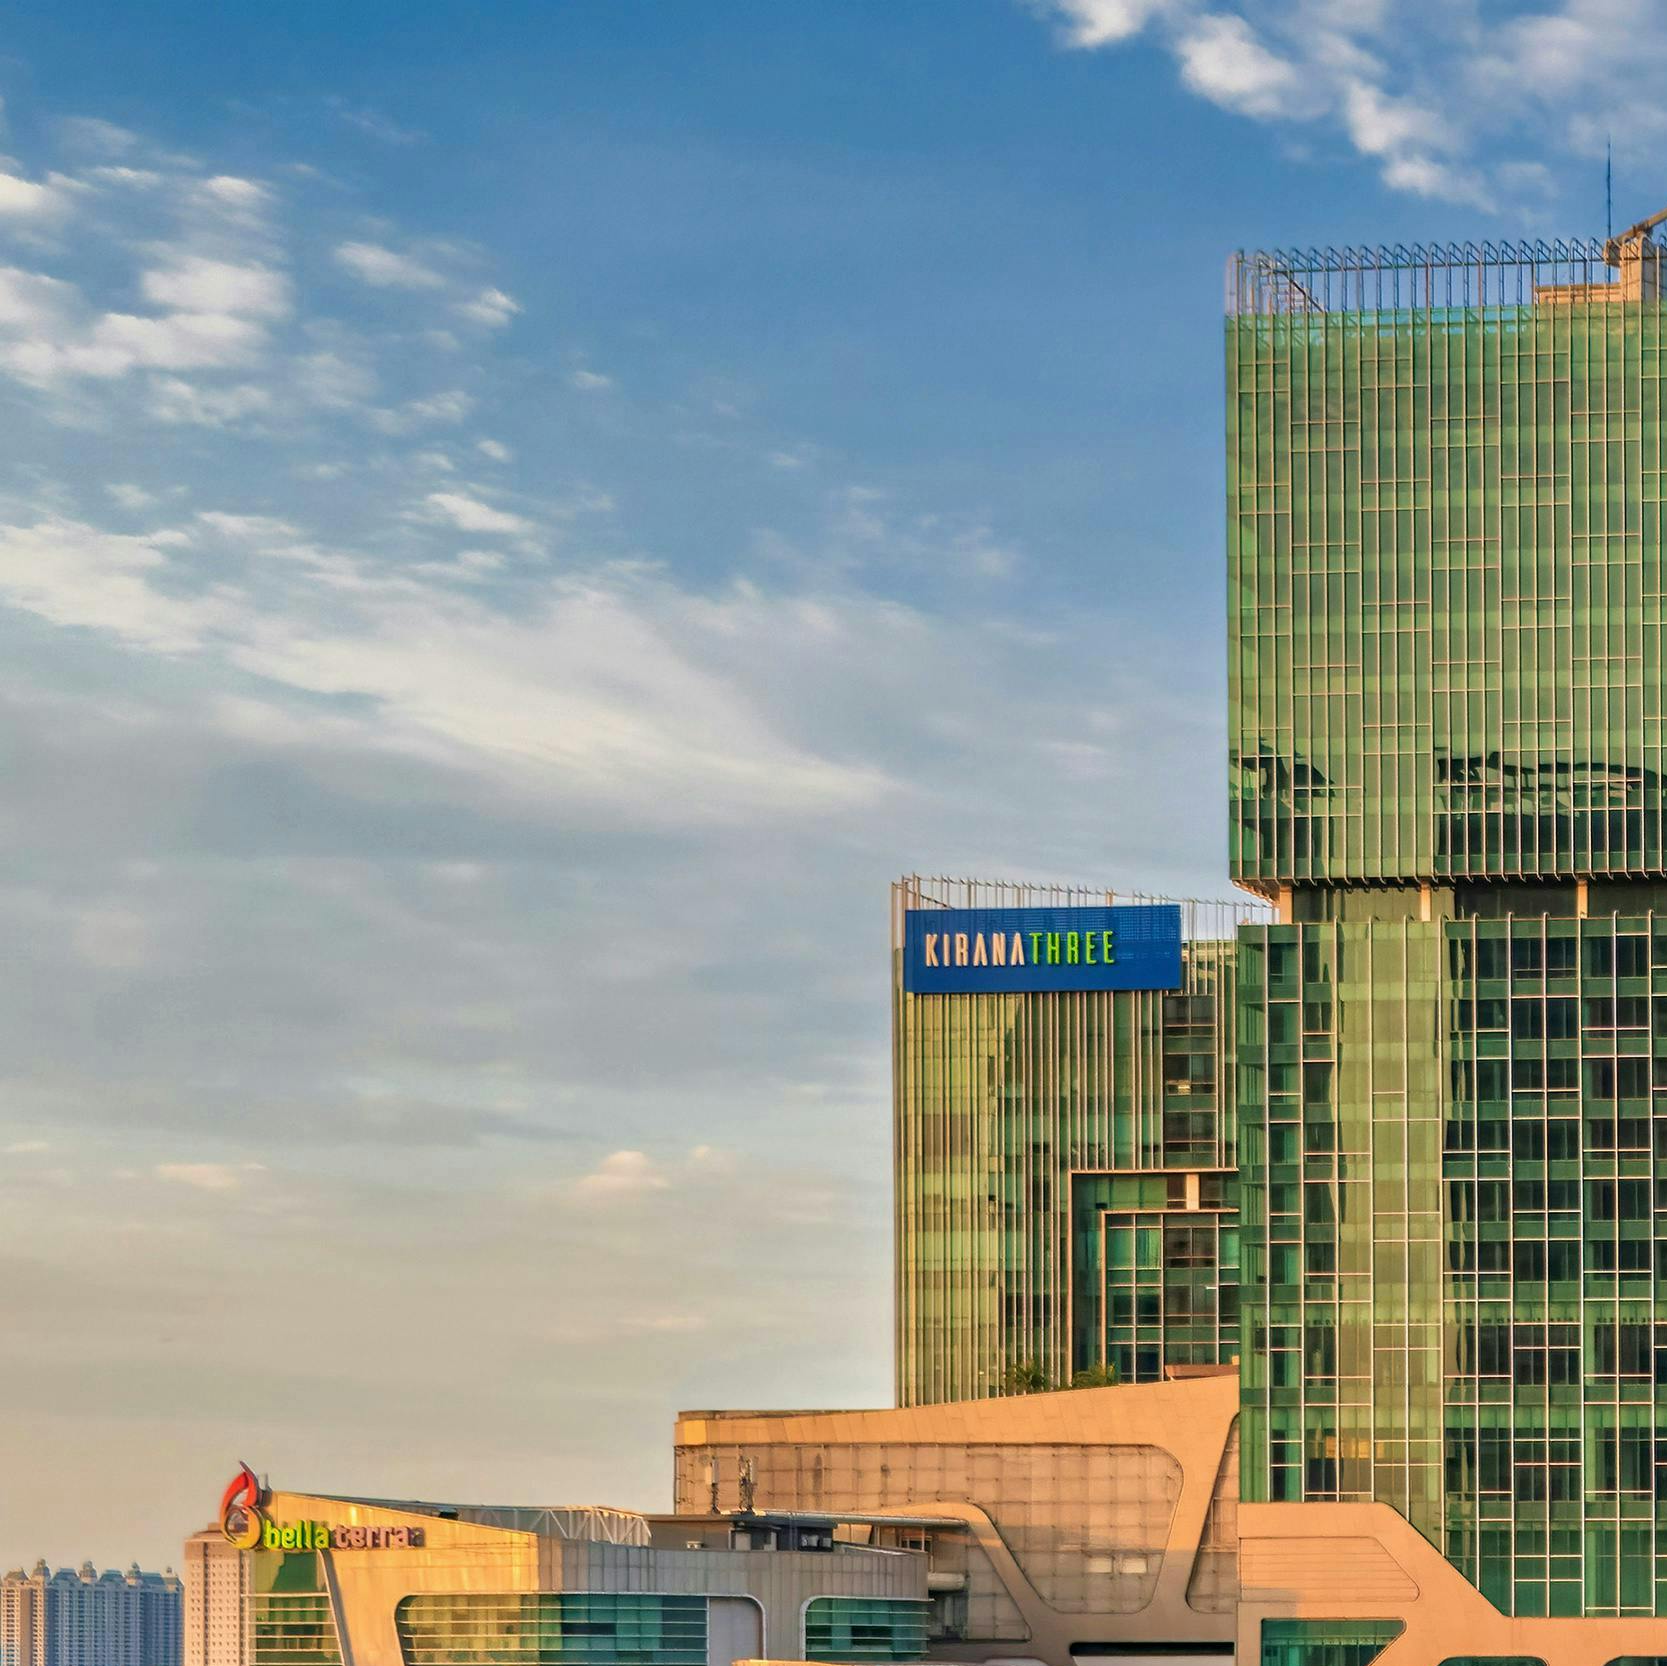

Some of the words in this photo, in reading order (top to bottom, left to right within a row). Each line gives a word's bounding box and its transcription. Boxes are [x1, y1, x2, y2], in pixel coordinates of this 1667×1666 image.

[926, 932, 1025, 967] KIRANA
[1029, 931, 1115, 965] THREE
[264, 1520, 330, 1549] bella
[335, 1524, 412, 1549] terra
